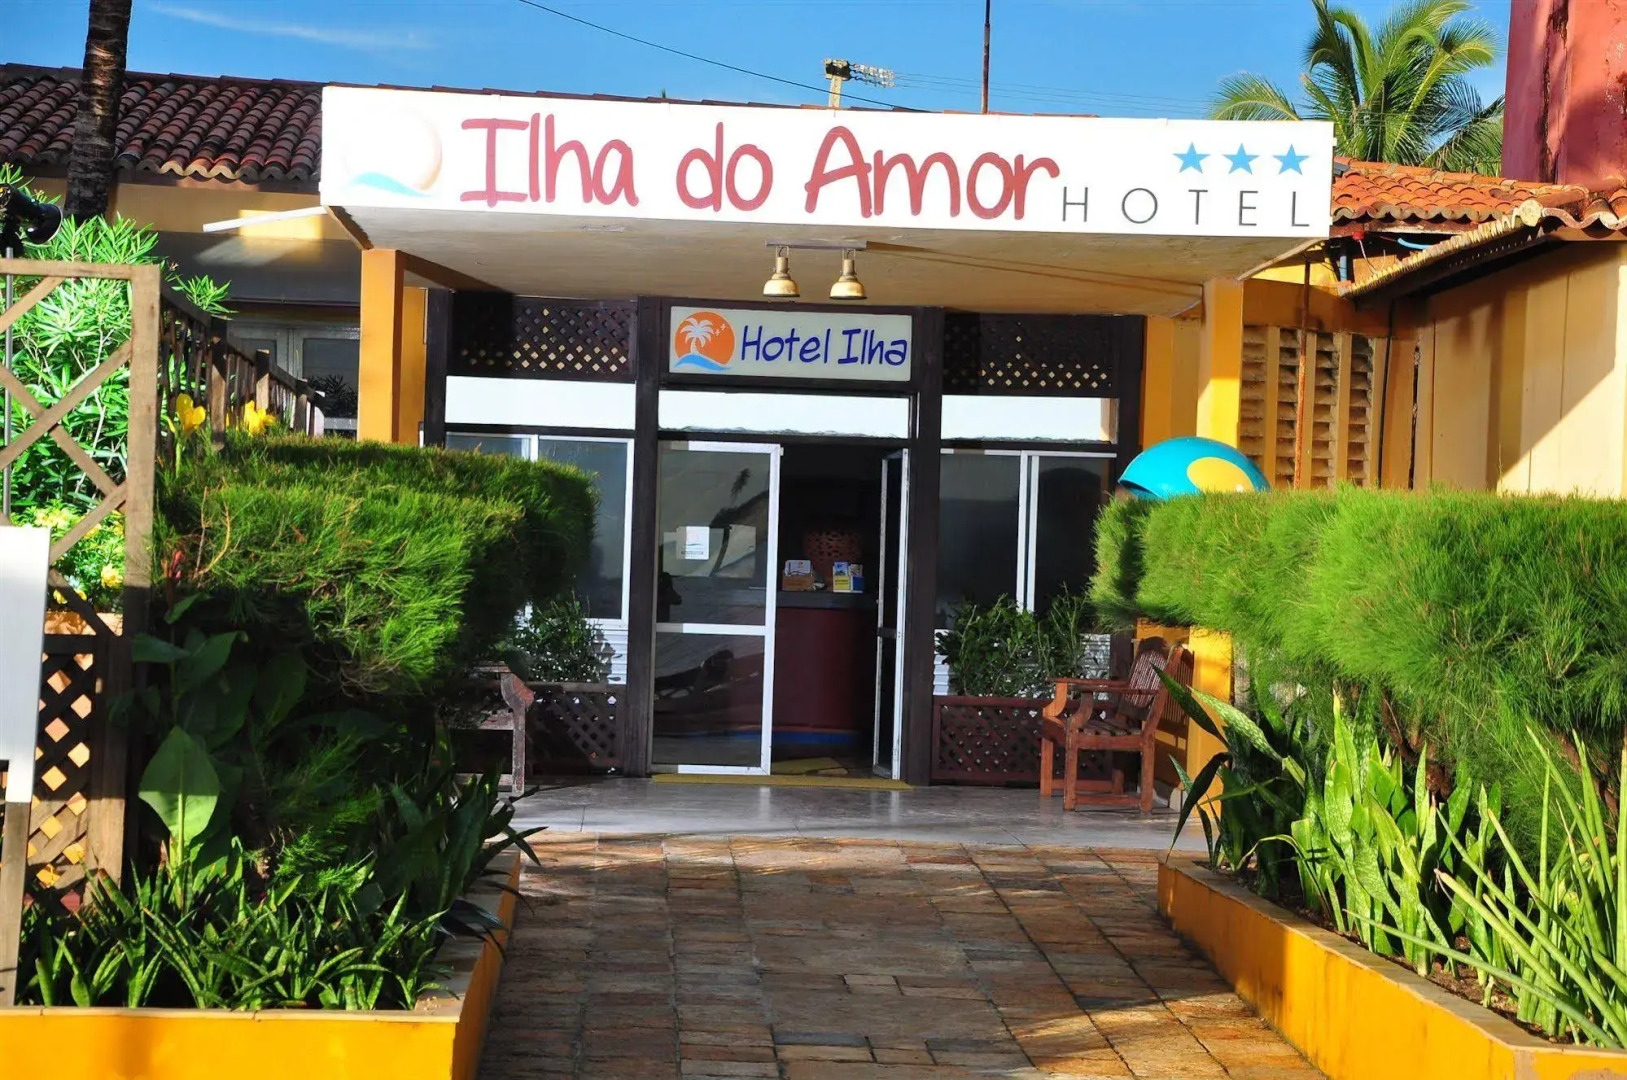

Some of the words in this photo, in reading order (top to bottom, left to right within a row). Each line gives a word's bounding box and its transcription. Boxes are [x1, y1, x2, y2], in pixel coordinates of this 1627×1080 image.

[461, 113, 639, 207] Ilha
[676, 122, 774, 212] do
[804, 125, 1060, 221] Amor
[1061, 186, 1311, 228] HOTEL
[740, 325, 831, 364] Hotel
[837, 328, 908, 366] Ilha
